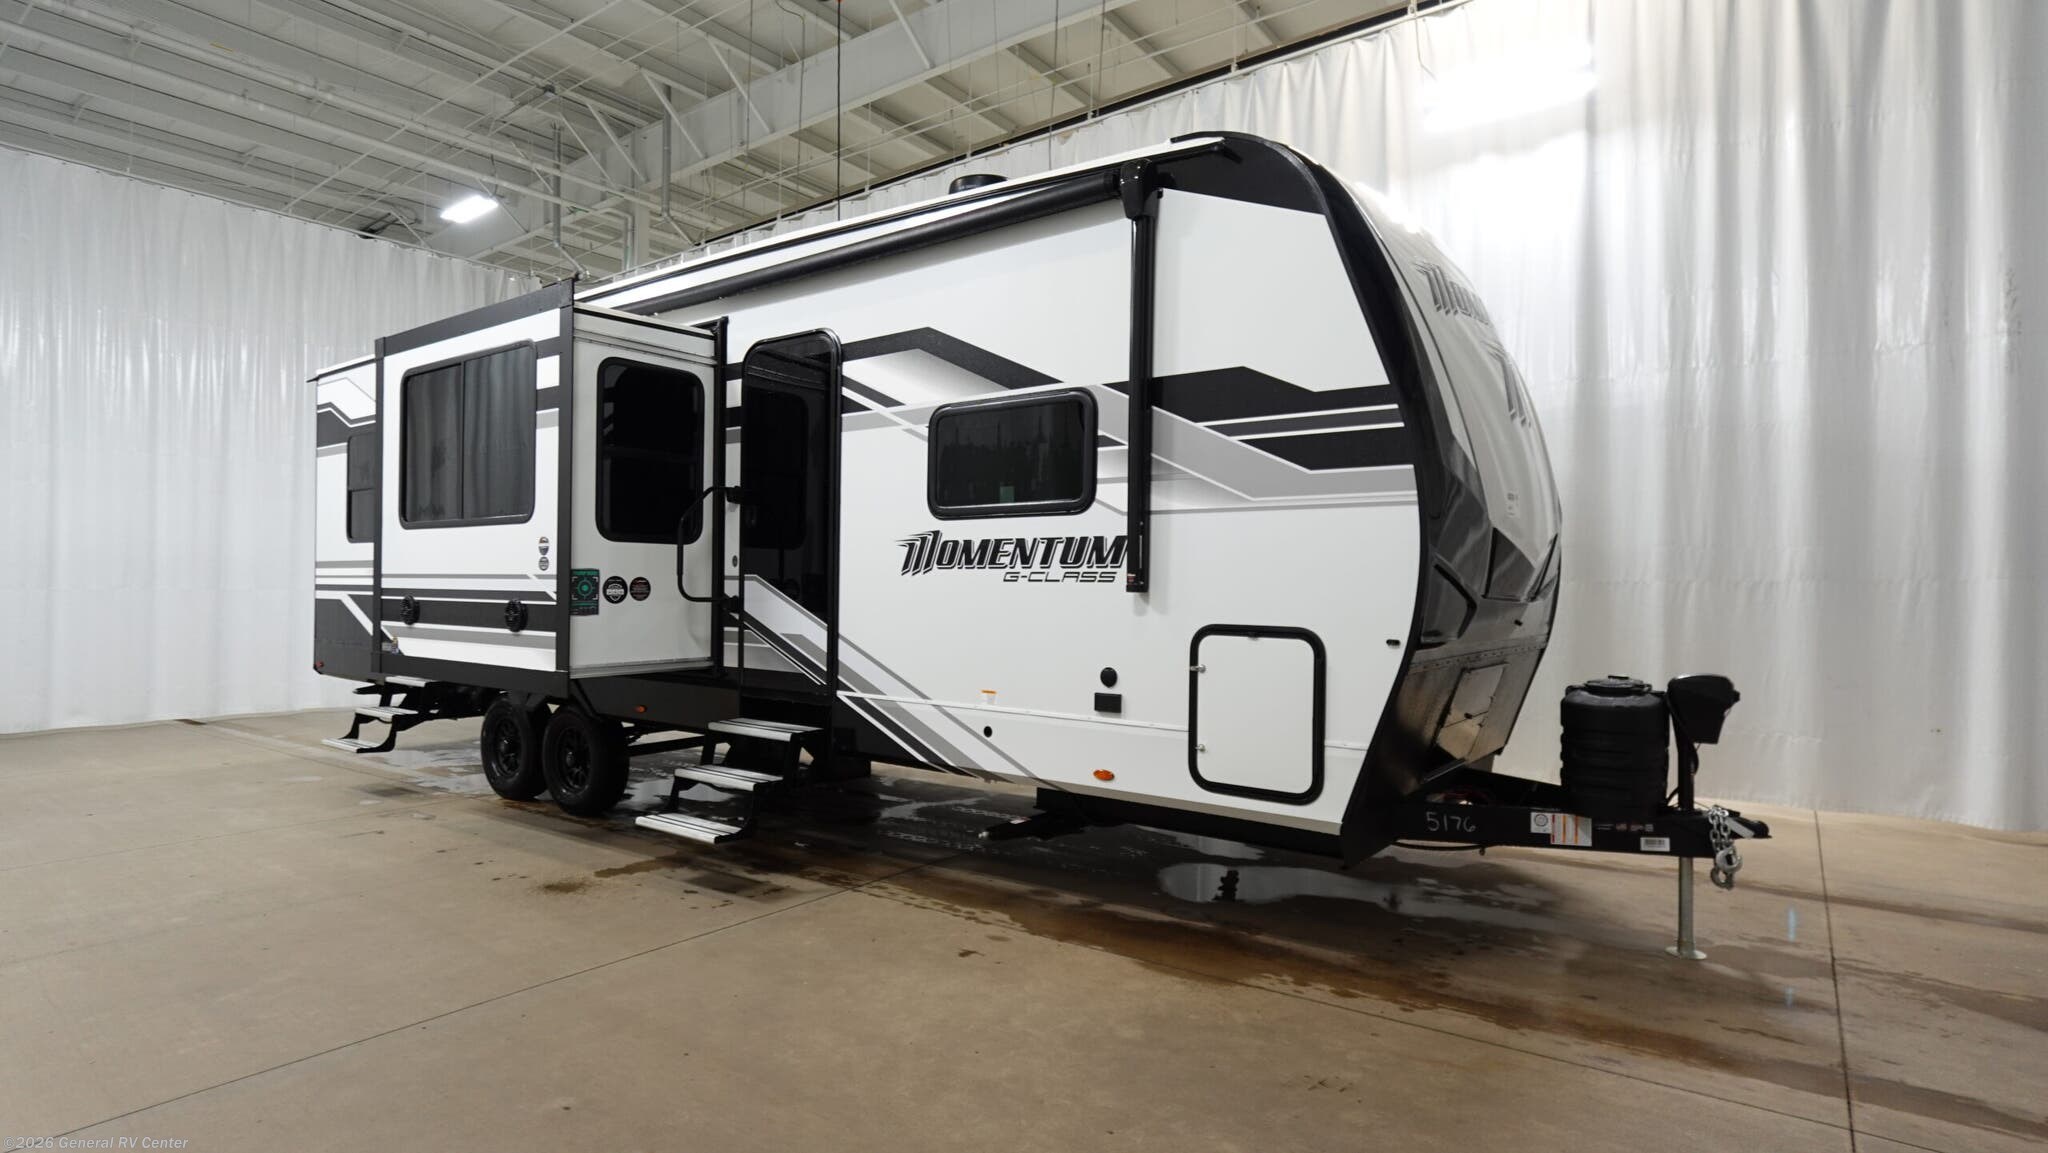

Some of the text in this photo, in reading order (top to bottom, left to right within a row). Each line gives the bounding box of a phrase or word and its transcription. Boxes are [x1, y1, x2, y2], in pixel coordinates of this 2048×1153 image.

[896, 530, 1128, 577] MOMENTUM
[1003, 571, 1117, 583] G-CLASS
[1426, 811, 1476, 832] 5176
